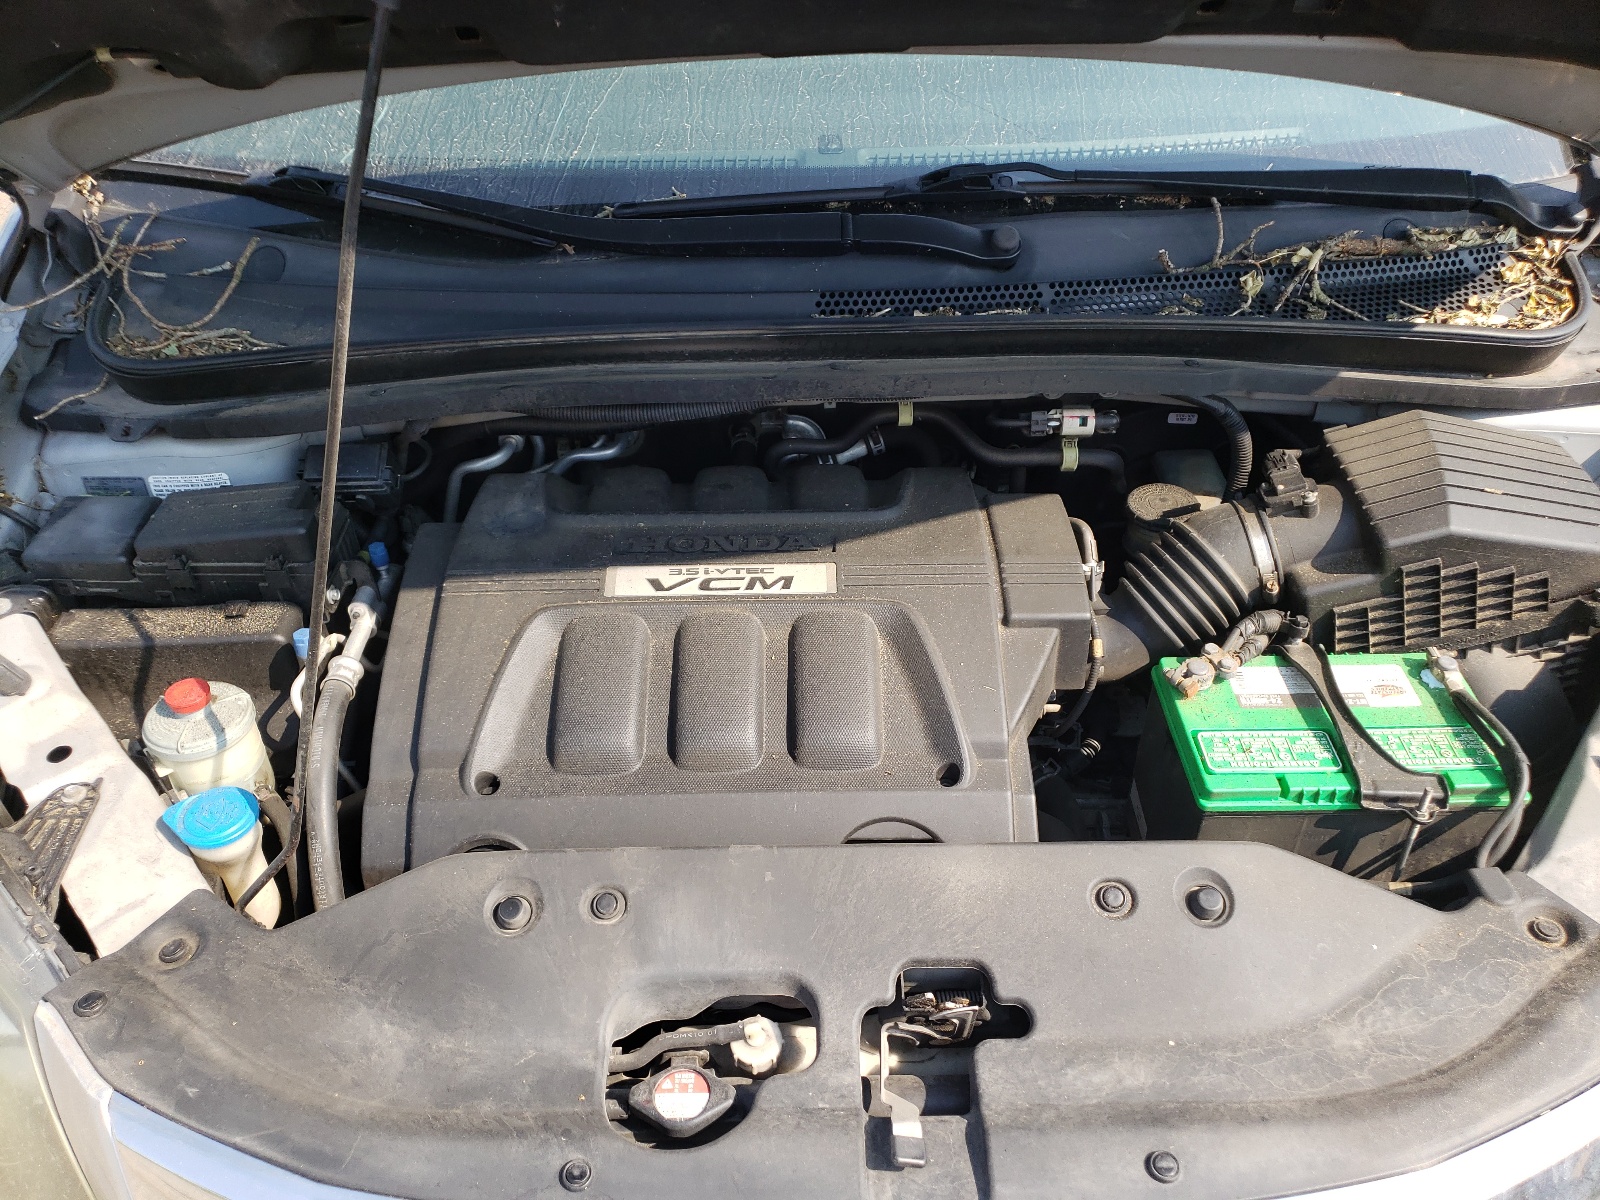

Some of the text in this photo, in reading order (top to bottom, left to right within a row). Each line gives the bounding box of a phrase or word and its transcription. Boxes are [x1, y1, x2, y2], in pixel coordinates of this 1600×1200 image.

[623, 534, 820, 554] HONDA
[668, 568, 699, 576] 3.5
[645, 575, 795, 593] VCM
